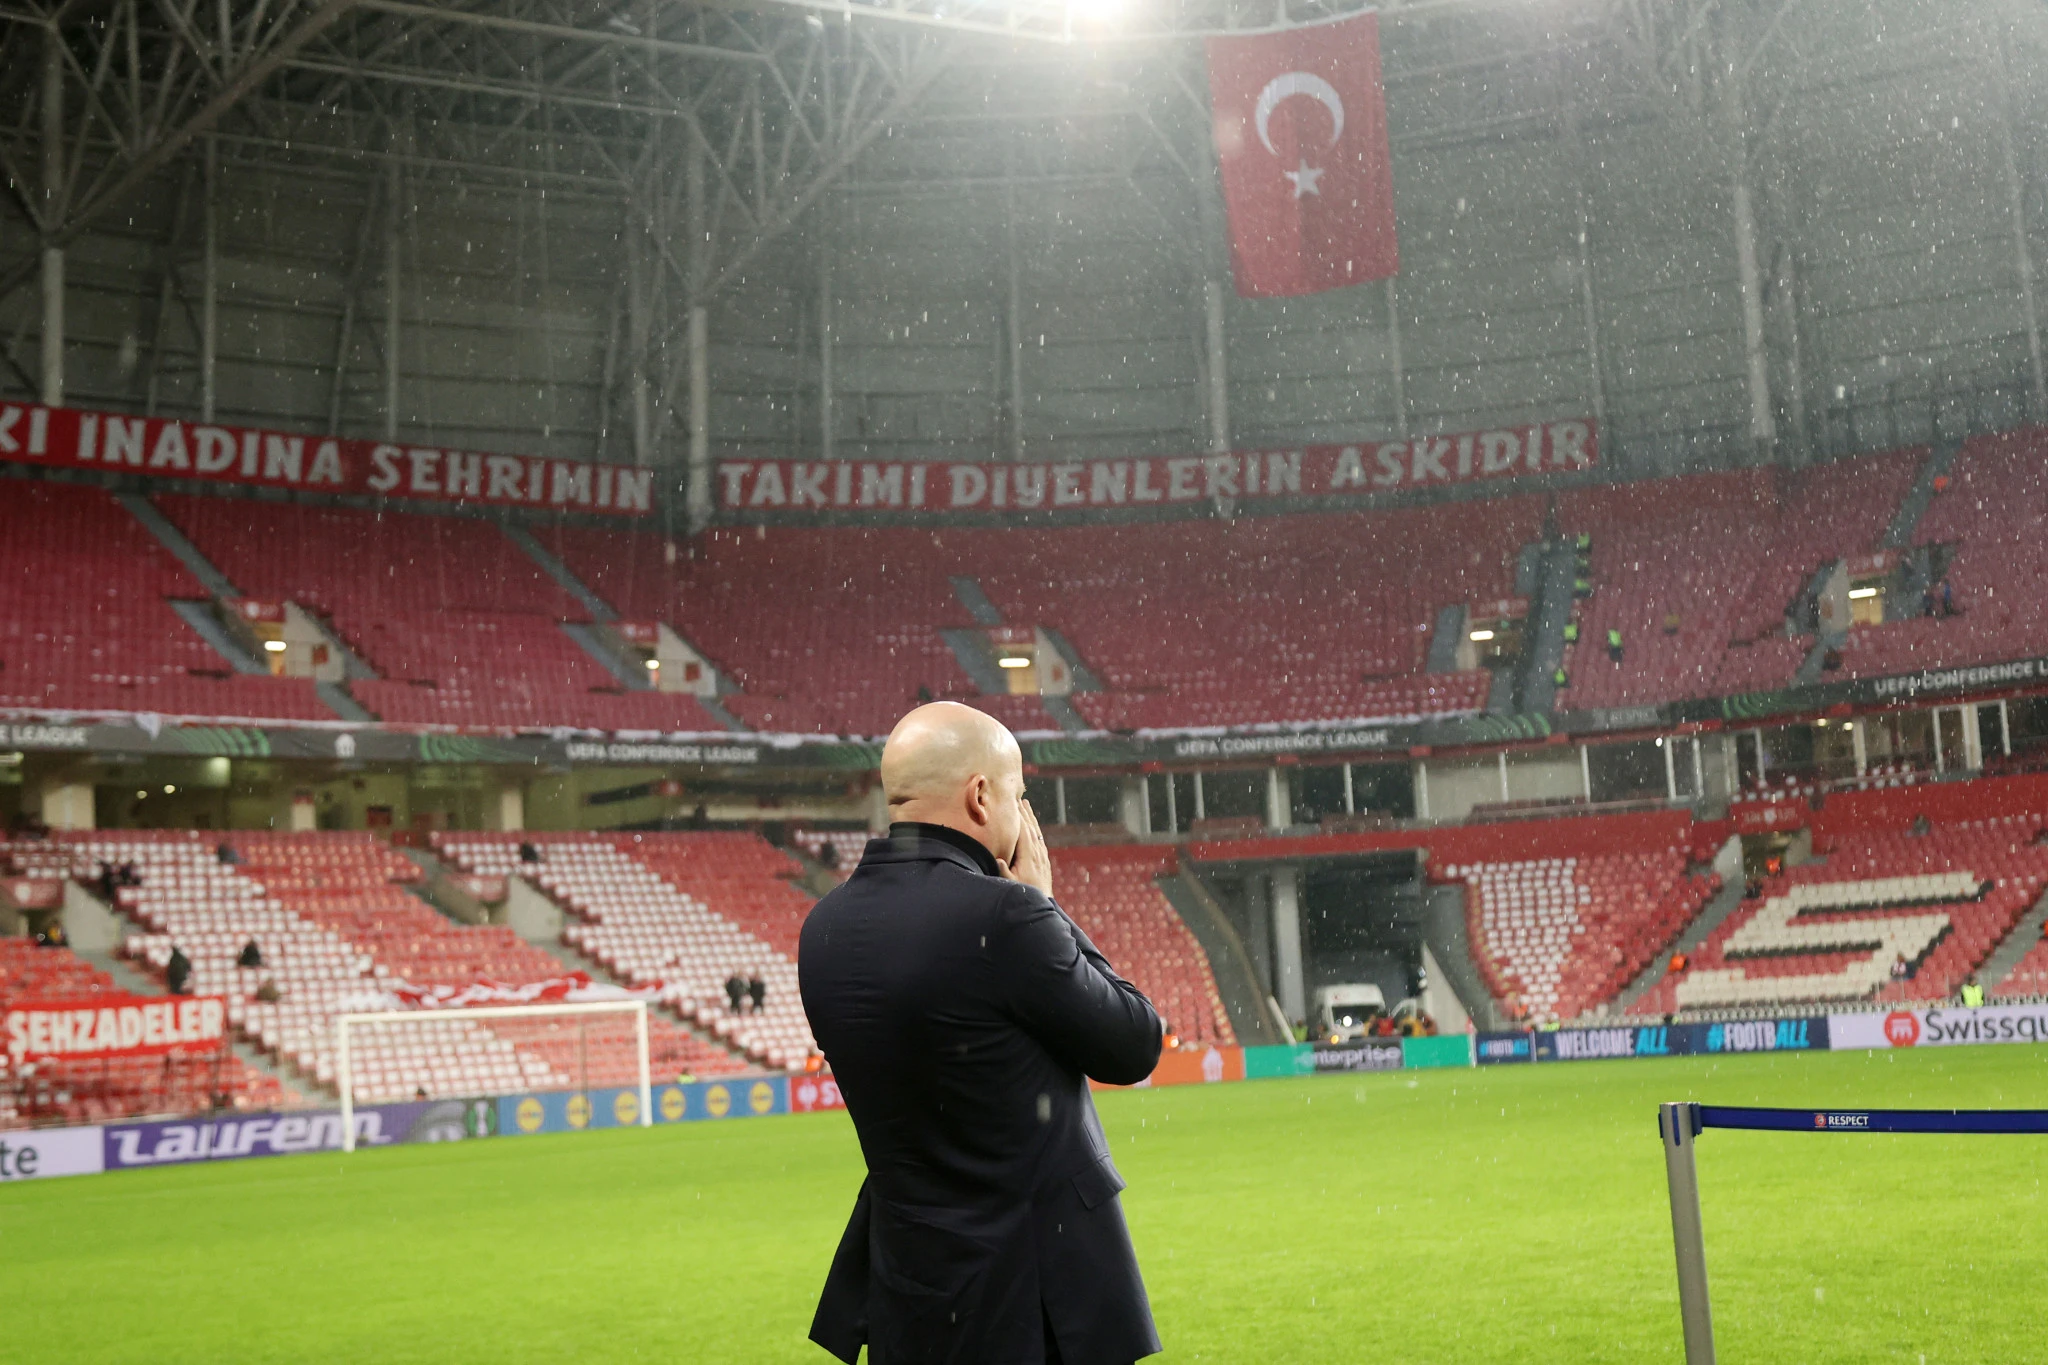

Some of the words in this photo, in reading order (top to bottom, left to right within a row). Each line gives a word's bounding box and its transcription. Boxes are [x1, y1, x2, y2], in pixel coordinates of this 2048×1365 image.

[718, 462, 927, 507] TAKIMI
[1874, 676, 1920, 697] UEFA
[12, 725, 88, 747] LEAGUE
[1175, 740, 1219, 755] UEFA
[1222, 733, 1326, 751] CONFERENCE
[1328, 729, 1388, 746] LEAGUE
[566, 743, 606, 760] UEFA
[608, 744, 700, 761] CONFERENCE
[704, 747, 758, 762] LEAGUE
[1555, 1028, 1634, 1059] WELCOME
[1636, 1026, 1669, 1055] ALL
[1706, 1020, 1809, 1051] #FOOTBALL
[1828, 1115, 1869, 1126] RESPECT
